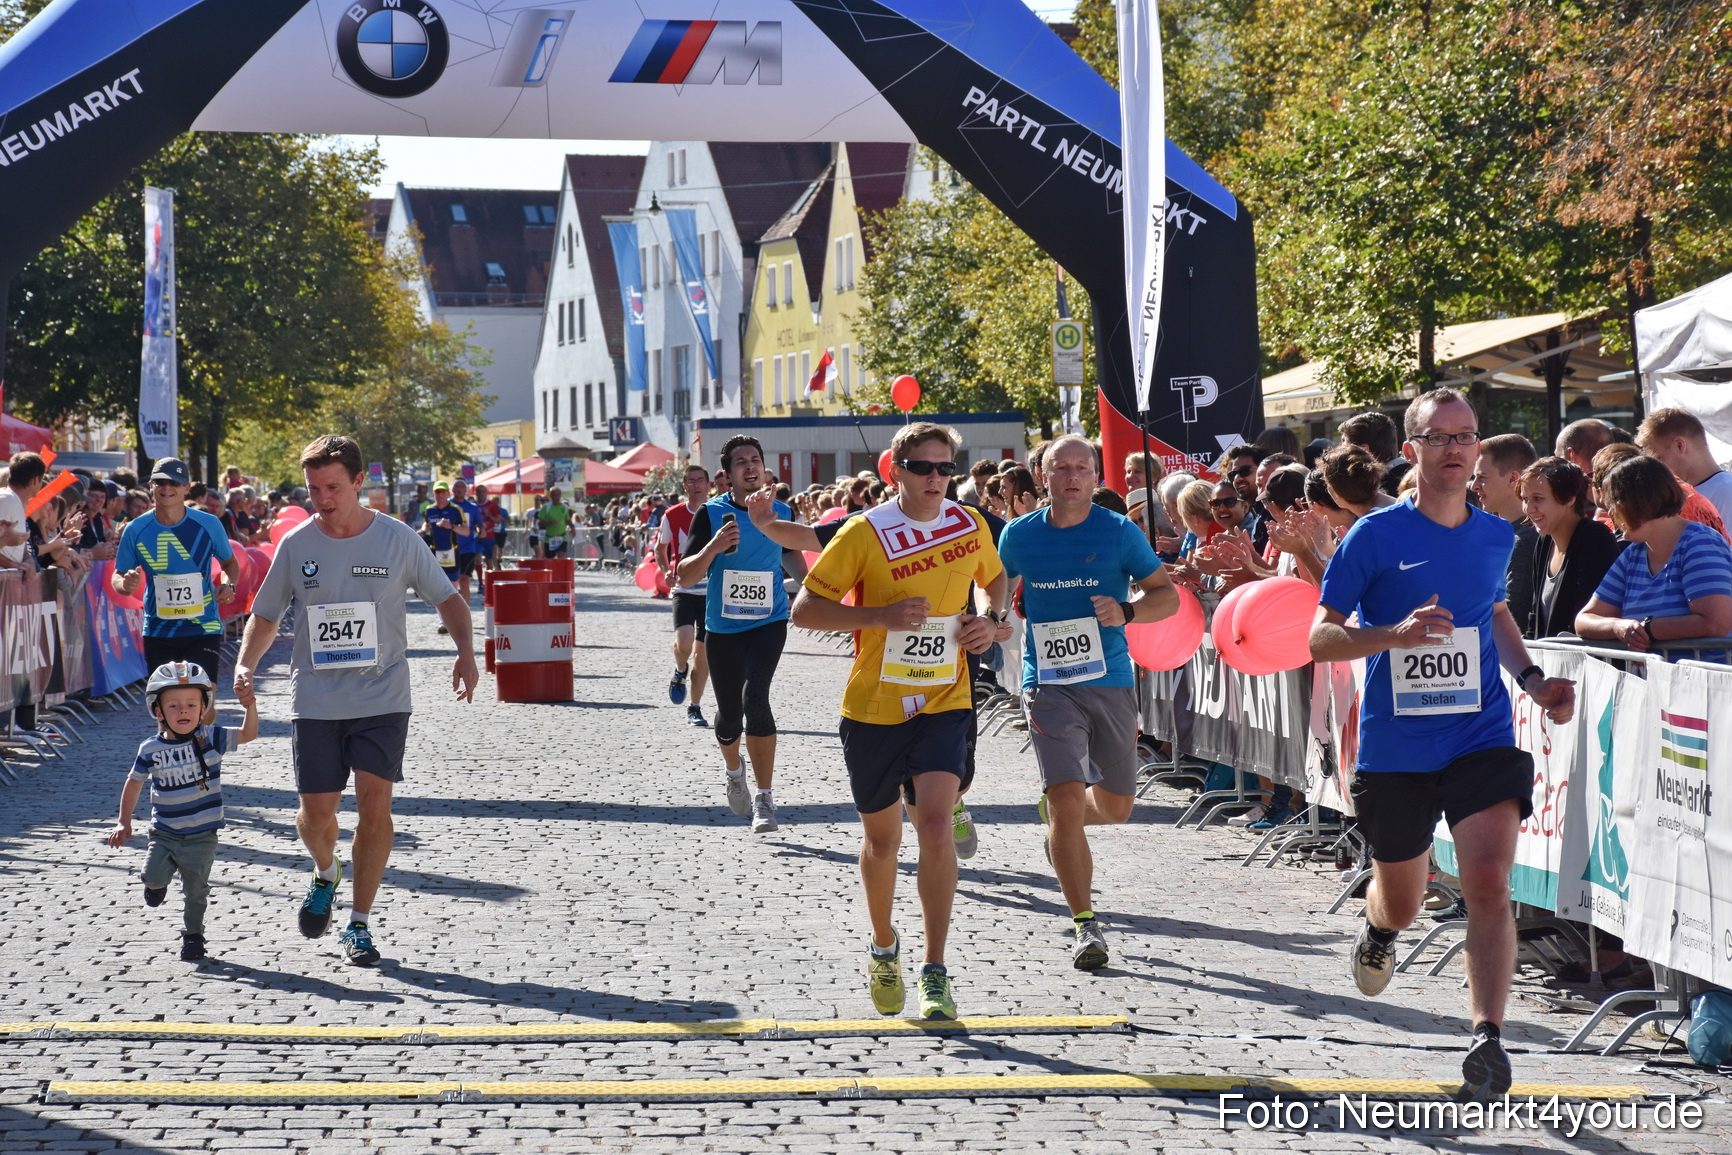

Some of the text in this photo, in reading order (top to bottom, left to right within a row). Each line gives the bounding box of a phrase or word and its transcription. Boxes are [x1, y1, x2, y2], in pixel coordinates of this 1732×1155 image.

[962, 86, 1047, 153] PARTL
[1161, 452, 1212, 465] THE NEXT
[891, 538, 981, 581] MAX BÖGL
[352, 566, 388, 575] BOCK
[1031, 578, 1099, 589] www.hasit.de
[166, 587, 192, 601] 173
[730, 584, 766, 600] 2358
[318, 620, 365, 641] 2547
[920, 622, 945, 630] OCK
[903, 635, 946, 657] 258
[1044, 634, 1091, 659] 2609
[326, 652, 361, 661] Thorsten
[907, 669, 935, 678] Julian
[1056, 666, 1088, 678] Stephan
[1404, 652, 1468, 679] 2600
[1421, 694, 1456, 705] Stefan
[152, 745, 196, 769] SIXTH
[159, 762, 203, 787] STREE
[1578, 890, 1596, 910] Jura
